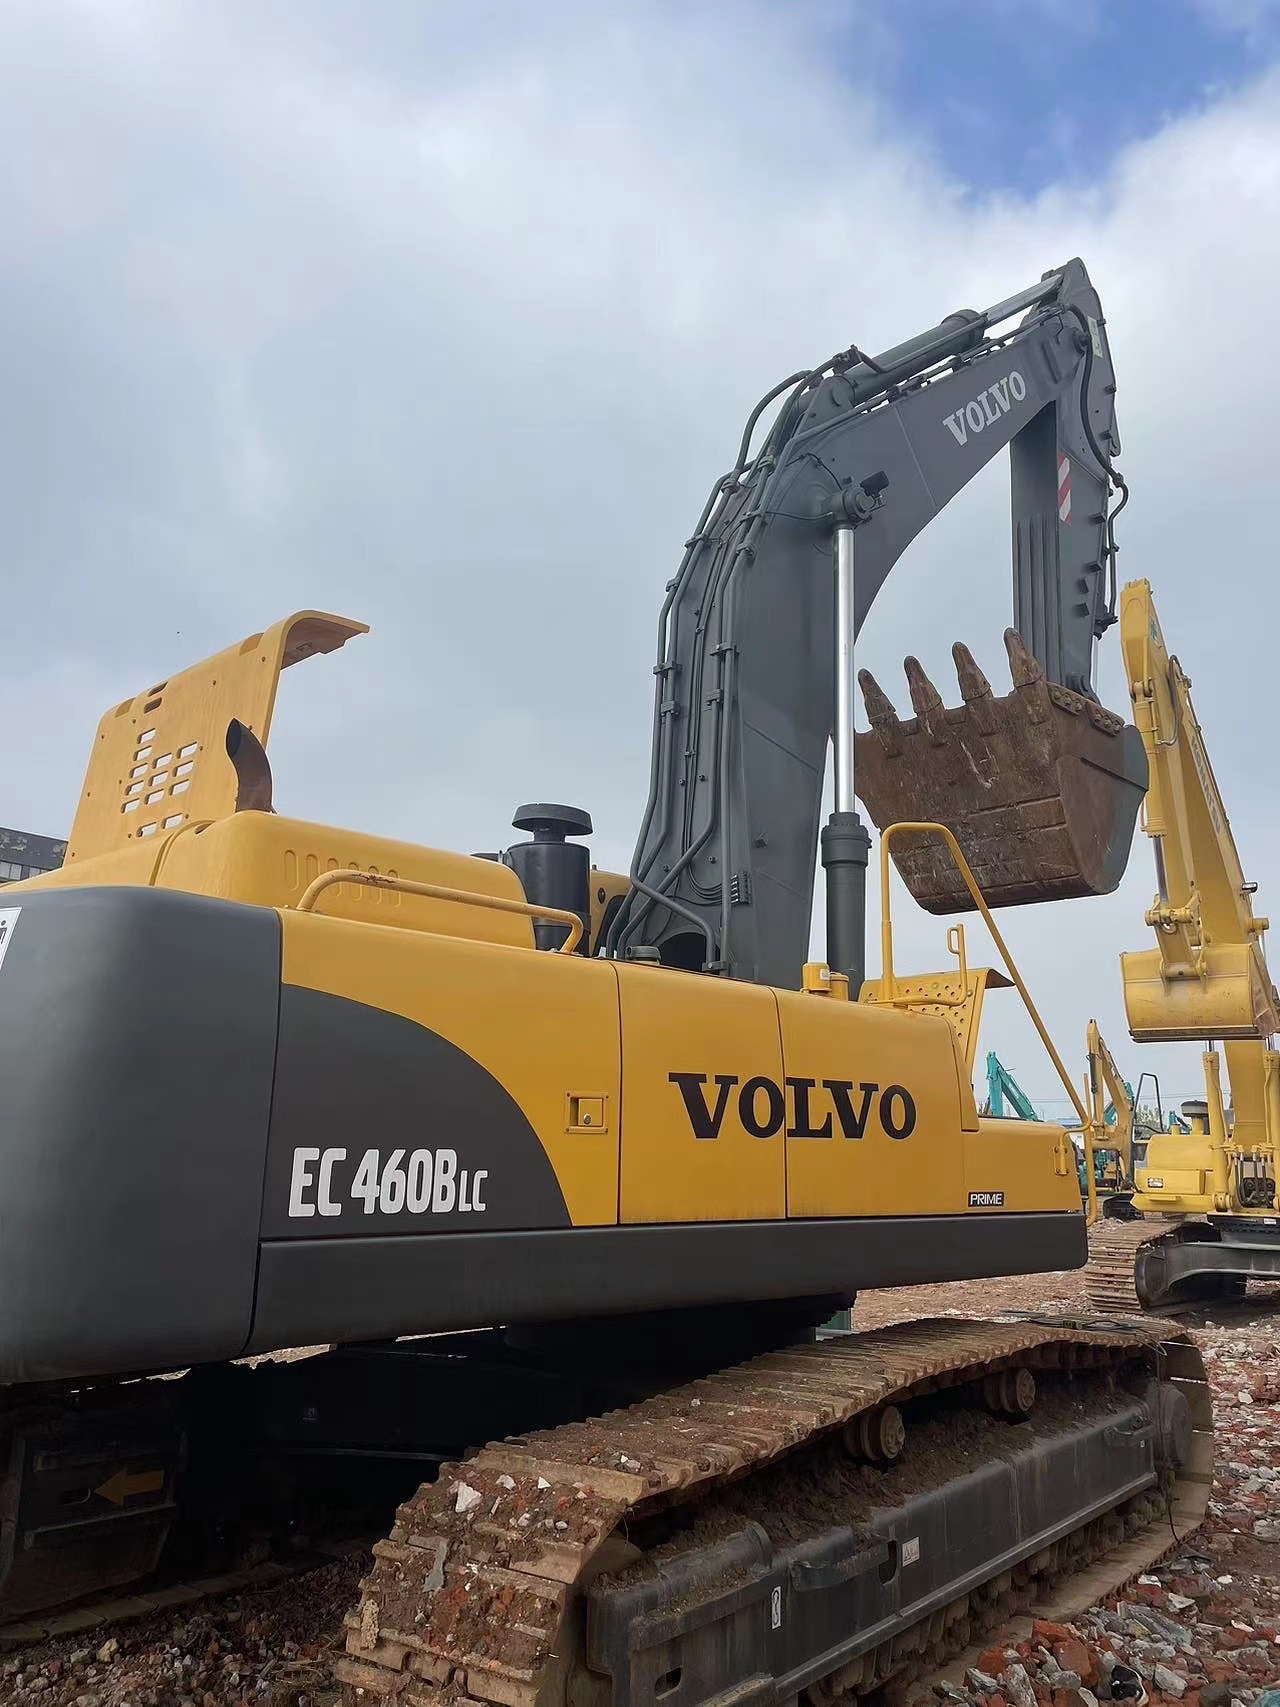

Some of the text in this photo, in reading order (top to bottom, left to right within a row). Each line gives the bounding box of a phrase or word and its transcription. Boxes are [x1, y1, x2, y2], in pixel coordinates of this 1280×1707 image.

[942, 371, 1026, 446] VOLVO
[668, 1072, 917, 1140] VOLVO
[288, 1147, 347, 1217] EC
[970, 1193, 1002, 1205] PRIME
